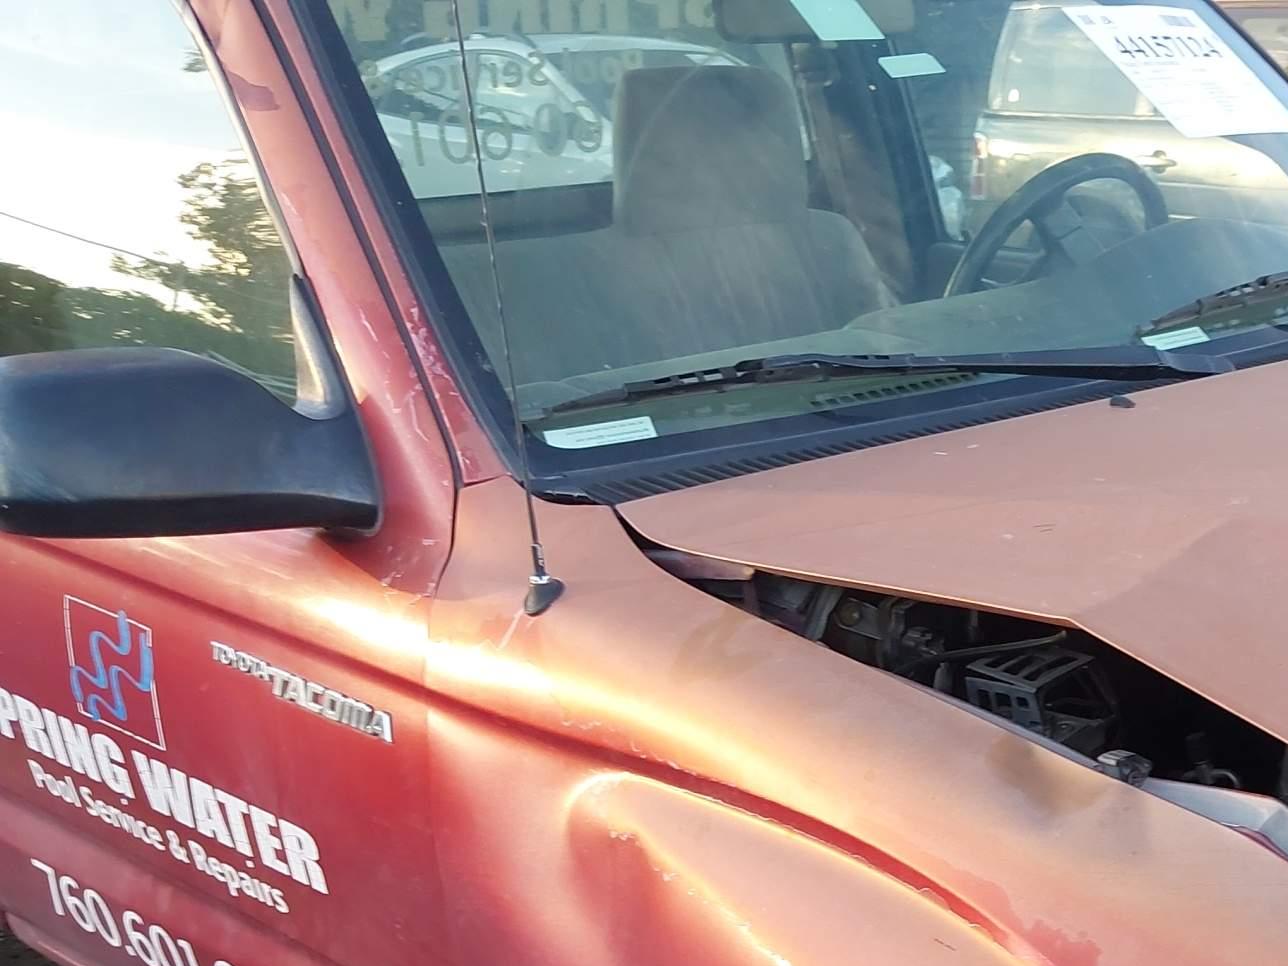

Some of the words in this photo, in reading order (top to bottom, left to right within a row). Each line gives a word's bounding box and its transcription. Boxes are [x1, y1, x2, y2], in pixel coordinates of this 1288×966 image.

[265, 667, 393, 743] TACOMA
[27, 759, 82, 807] Pool
[79, 786, 166, 850] Service
[166, 830, 190, 863] &
[187, 840, 289, 913] Repairs
[131, 750, 329, 894] WATER
